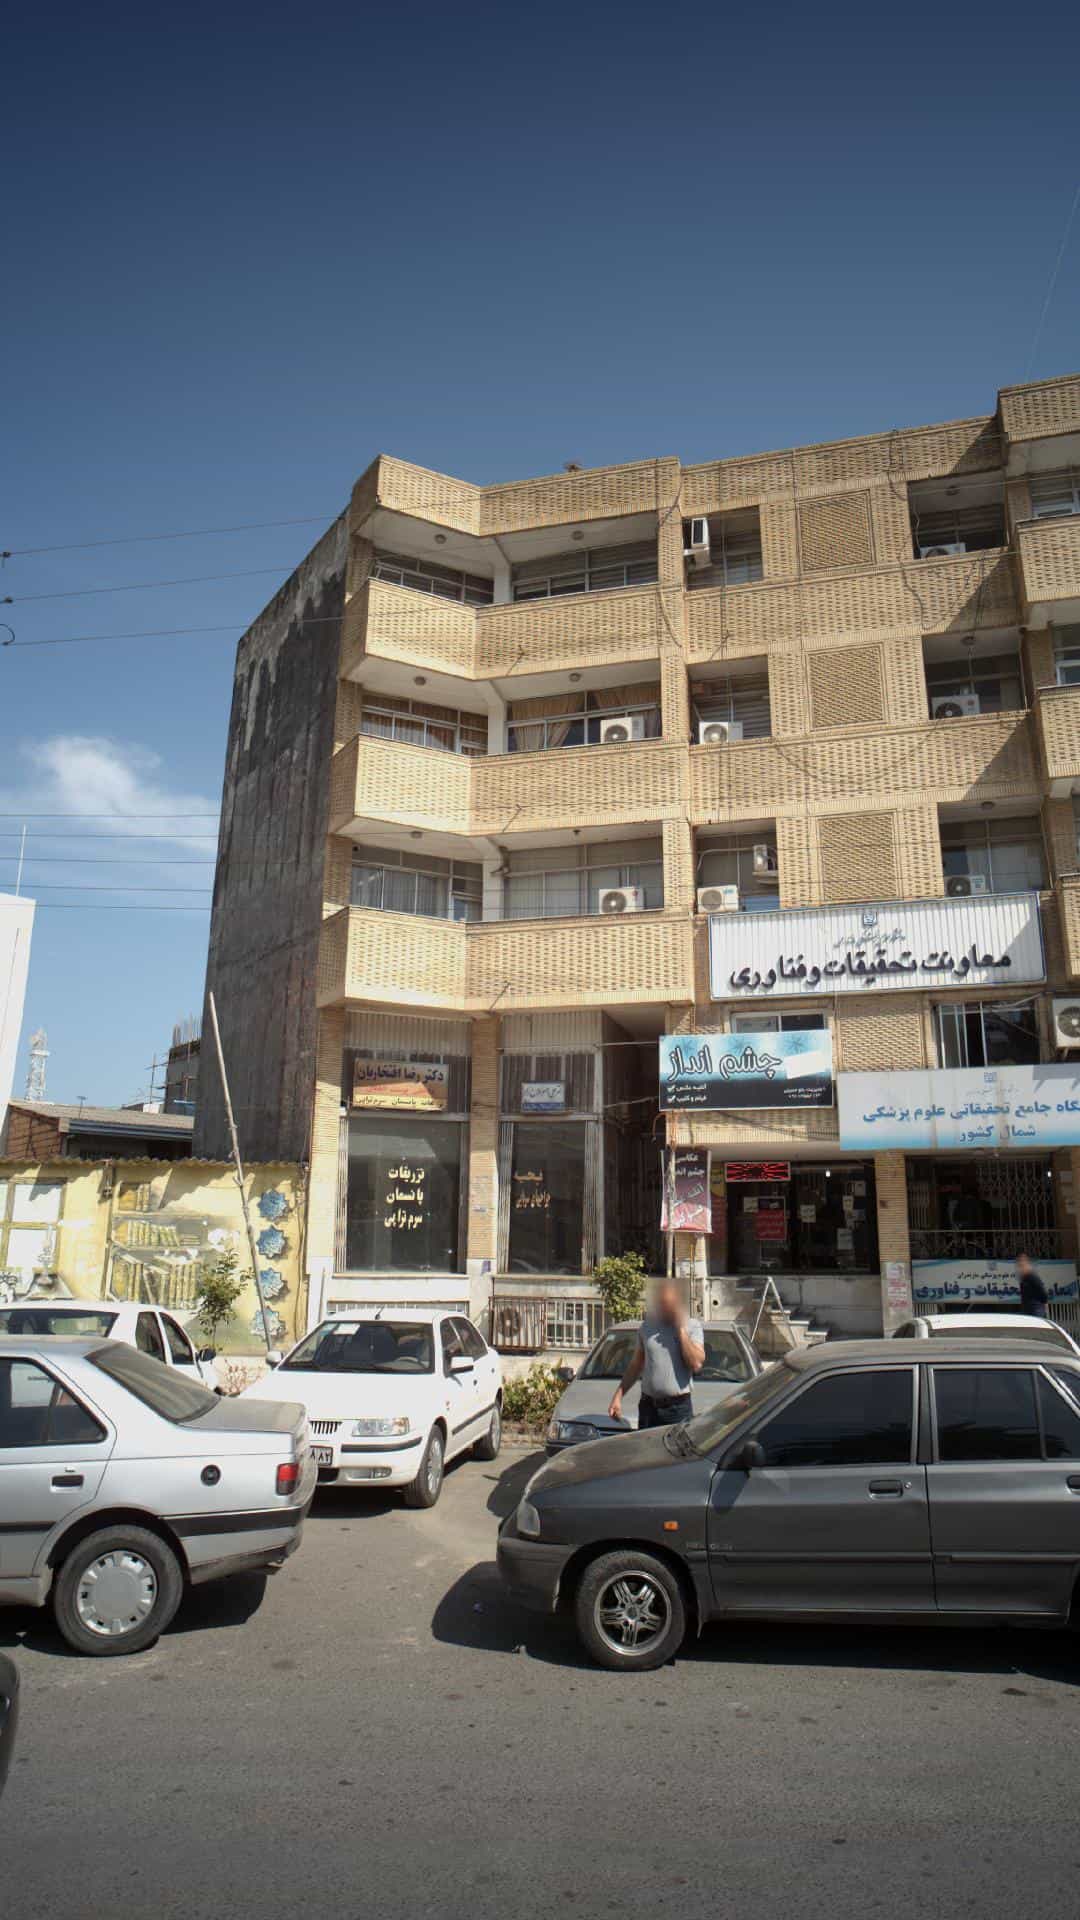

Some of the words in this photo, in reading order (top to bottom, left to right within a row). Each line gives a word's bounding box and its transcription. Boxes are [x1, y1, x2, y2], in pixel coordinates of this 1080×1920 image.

[823, 948, 918, 985] تحقیقات
[920, 944, 1012, 977] معاونت
[729, 954, 806, 989] فناوری
[667, 1043, 713, 1082] انداز
[719, 1046, 783, 1080] چشم
[425, 1068, 444, 1084] دکتر
[862, 1105, 912, 1123] پزشکی
[913, 1104, 945, 1121] علوم
[949, 1102, 1010, 1120] تحقیقاتی
[1014, 1100, 1051, 1118] جامع
[959, 1124, 995, 1143] کشور
[999, 1124, 1036, 1140] شمال
[388, 1164, 426, 1184] تزریقات
[386, 1186, 425, 1206] پانسمان
[914, 1280, 960, 1300] فناوری
[1048, 1281, 1074, 1299] معاو
